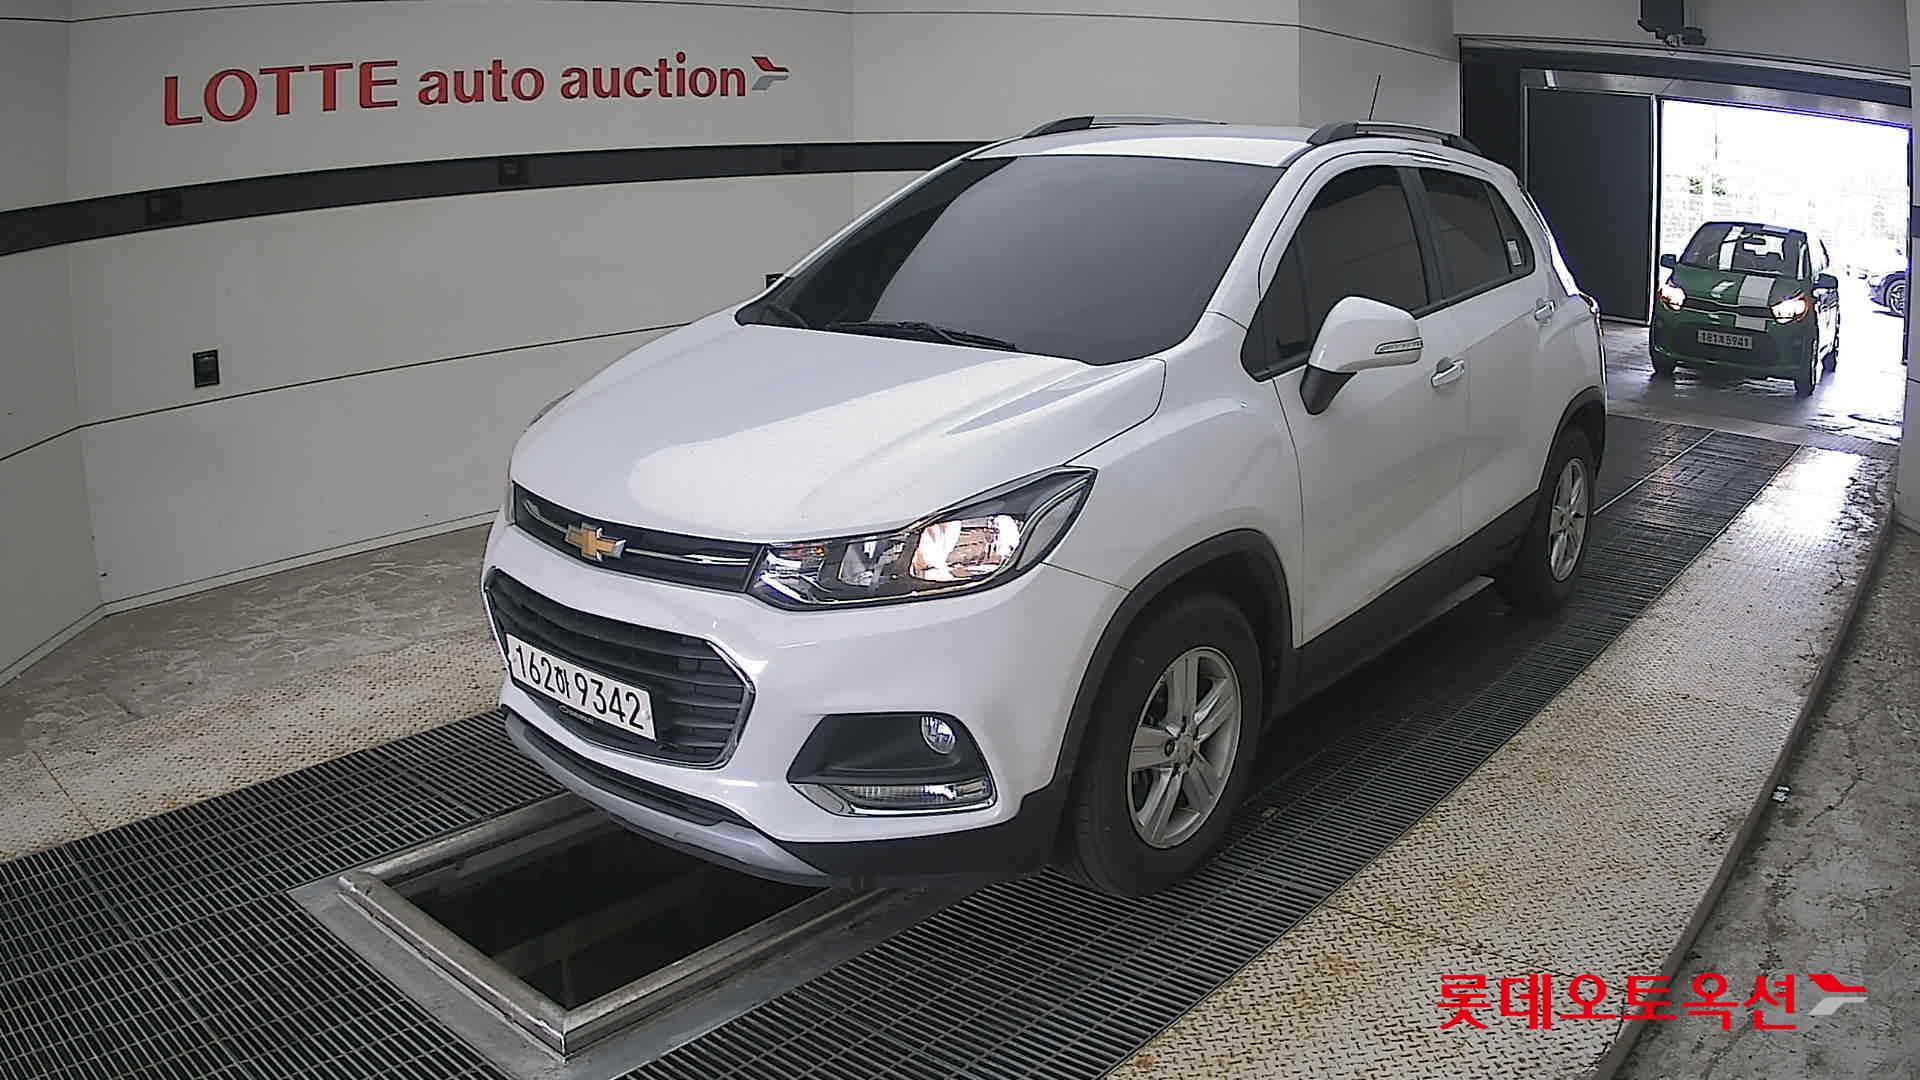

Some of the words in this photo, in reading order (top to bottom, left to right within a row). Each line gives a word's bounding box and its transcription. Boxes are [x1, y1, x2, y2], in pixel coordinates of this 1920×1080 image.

[164, 60, 398, 126] LOTTE
[418, 58, 545, 105] auto
[560, 51, 747, 99] auction
